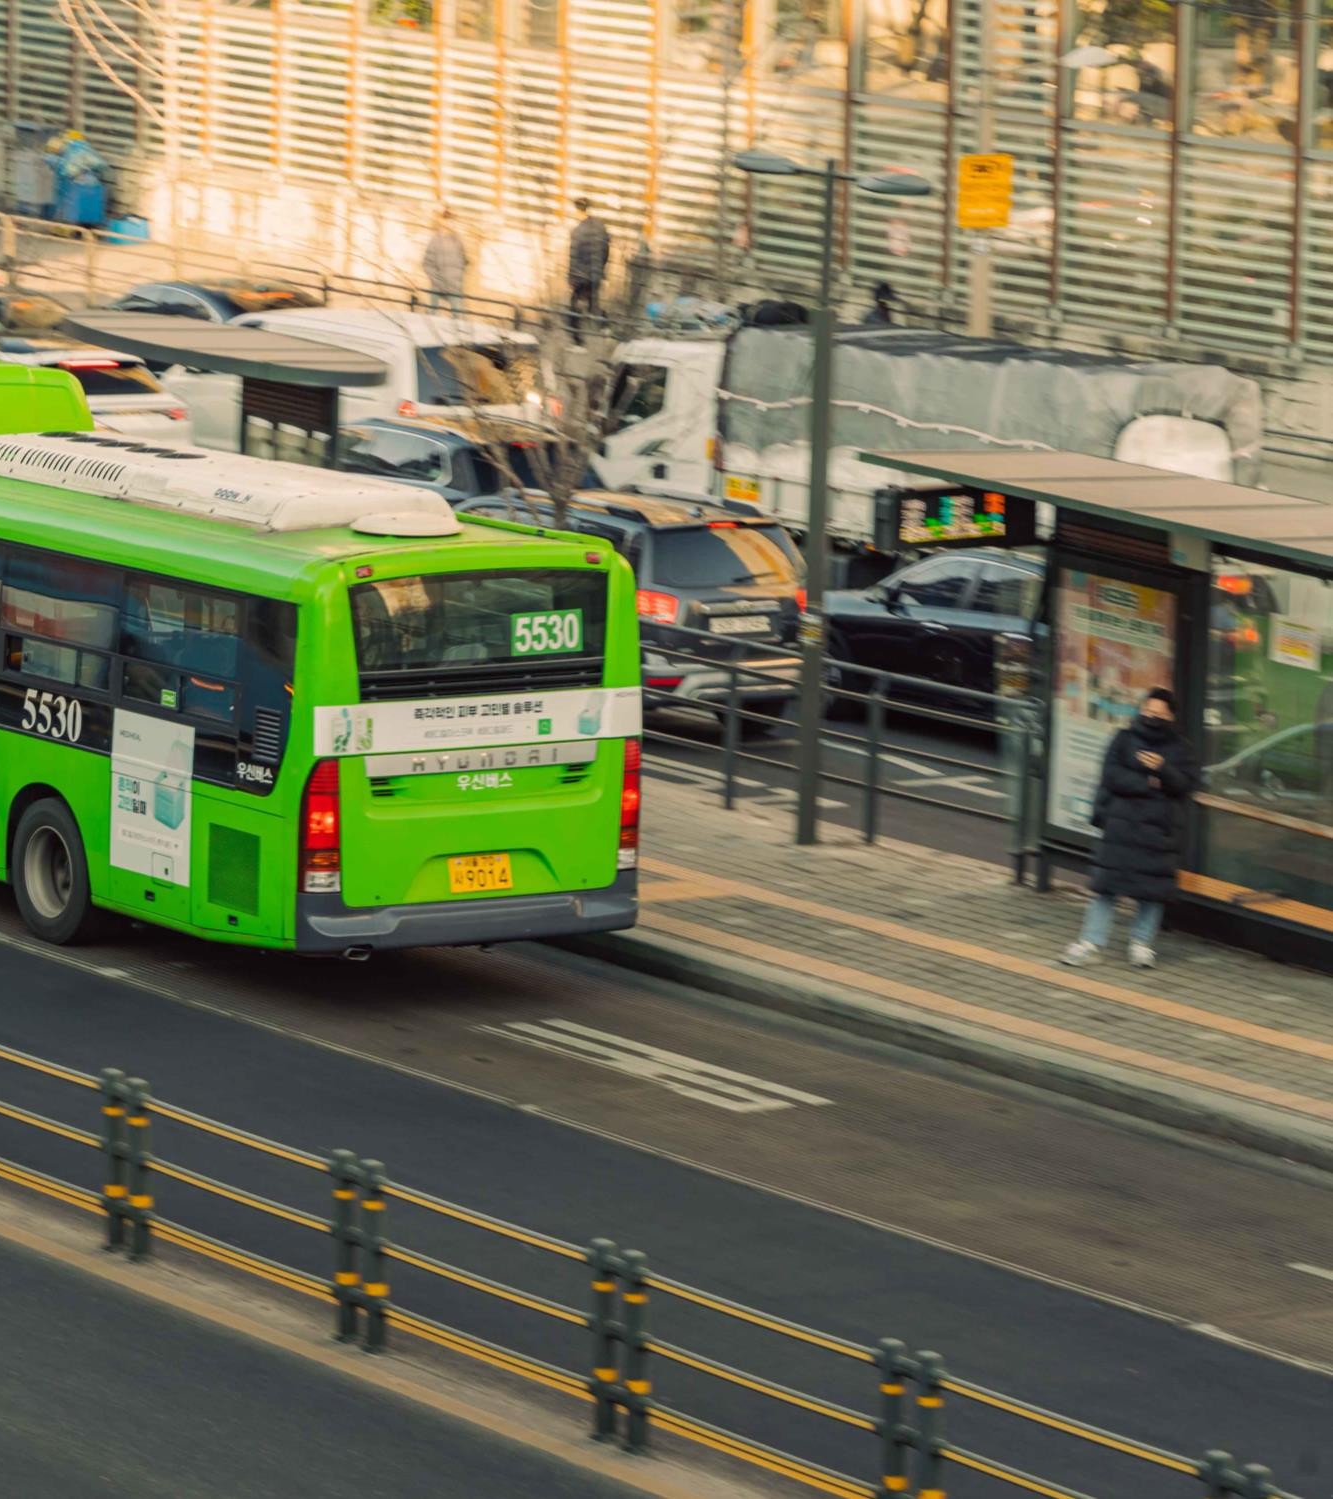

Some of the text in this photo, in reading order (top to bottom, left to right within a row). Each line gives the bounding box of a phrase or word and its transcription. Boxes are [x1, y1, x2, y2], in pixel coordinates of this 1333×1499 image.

[514, 612, 580, 653] 5530
[21, 687, 83, 743] 5530
[411, 748, 558, 772] HYUNDAI
[236, 762, 274, 785] 우신버스
[456, 772, 513, 791] 우신버스
